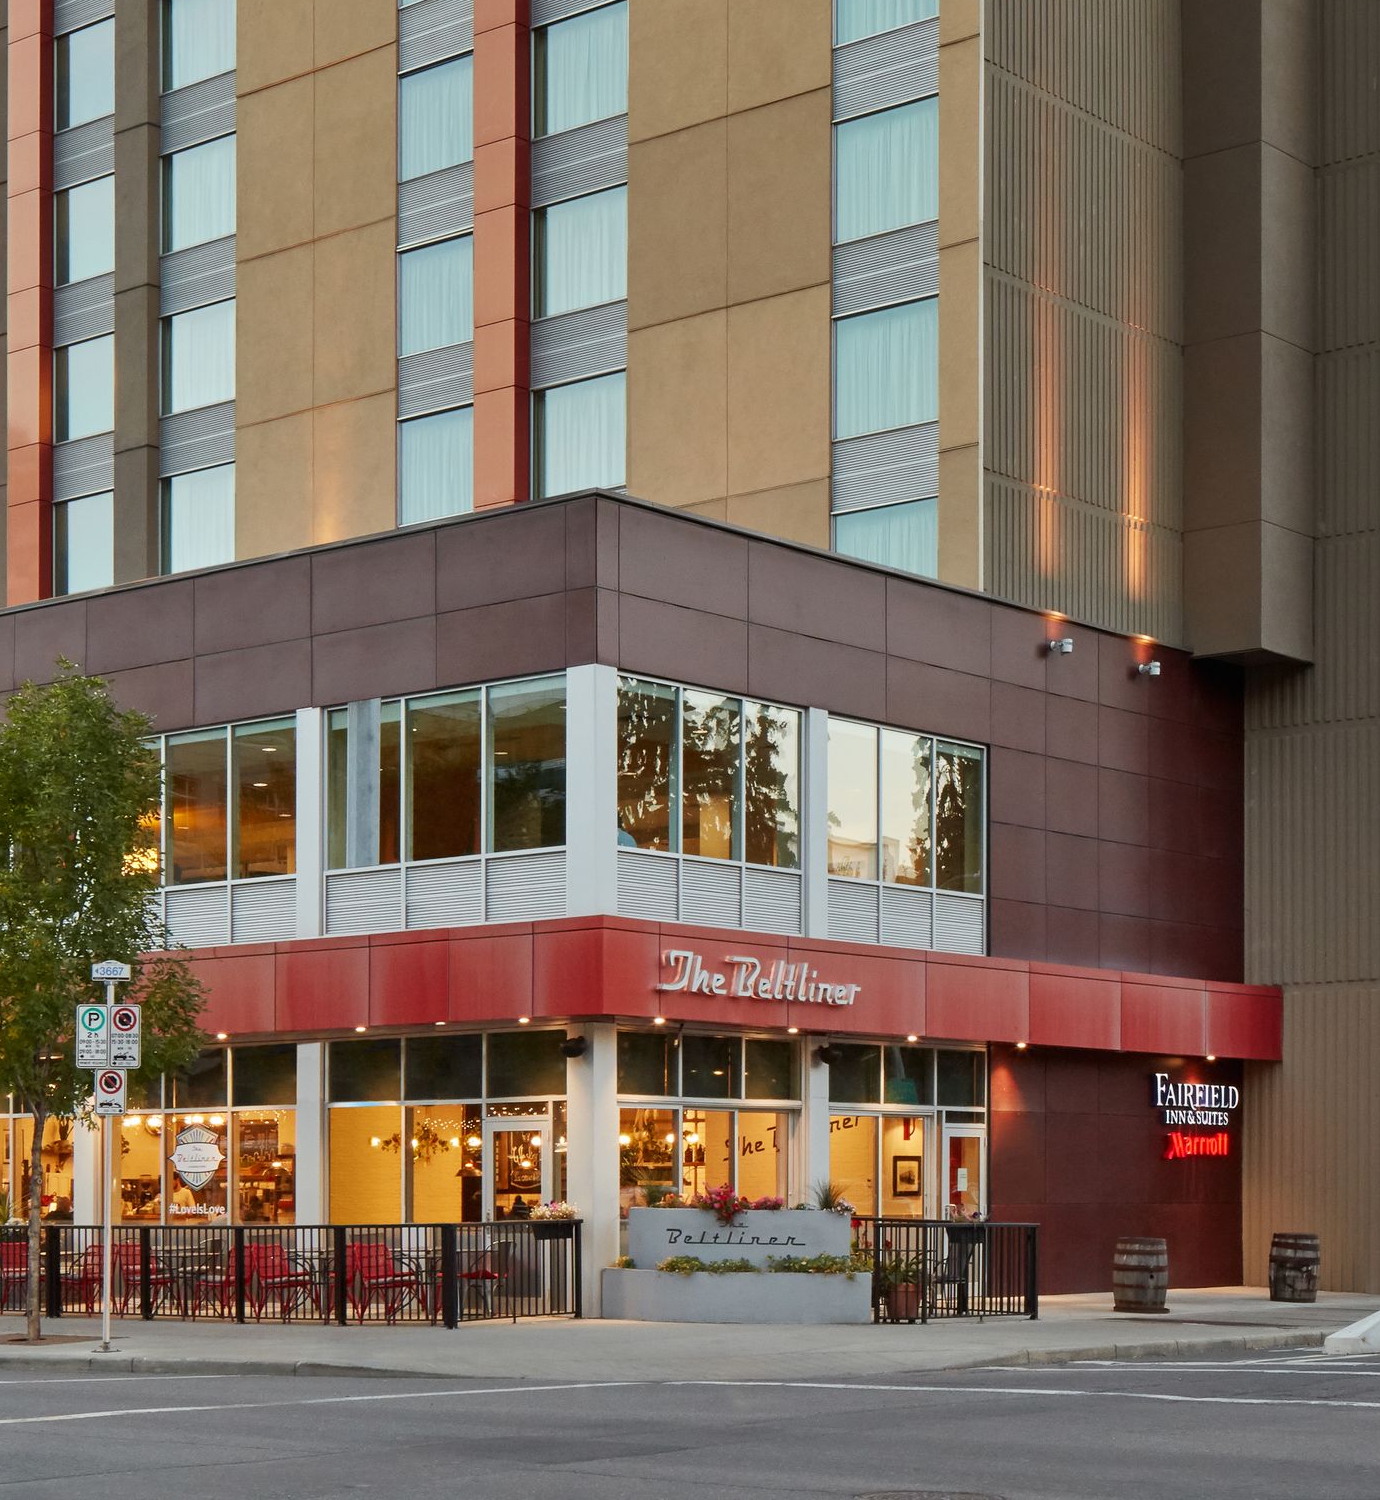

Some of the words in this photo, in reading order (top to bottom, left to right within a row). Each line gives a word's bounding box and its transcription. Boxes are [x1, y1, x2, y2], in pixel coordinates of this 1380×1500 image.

[99, 966, 125, 976] 3667
[656, 949, 728, 996] The
[725, 955, 862, 1006] Beltliner
[1165, 1132, 1228, 1160] Marriott
[168, 1203, 226, 1215] #LoveIsLove
[665, 1228, 807, 1247] Beltliner
